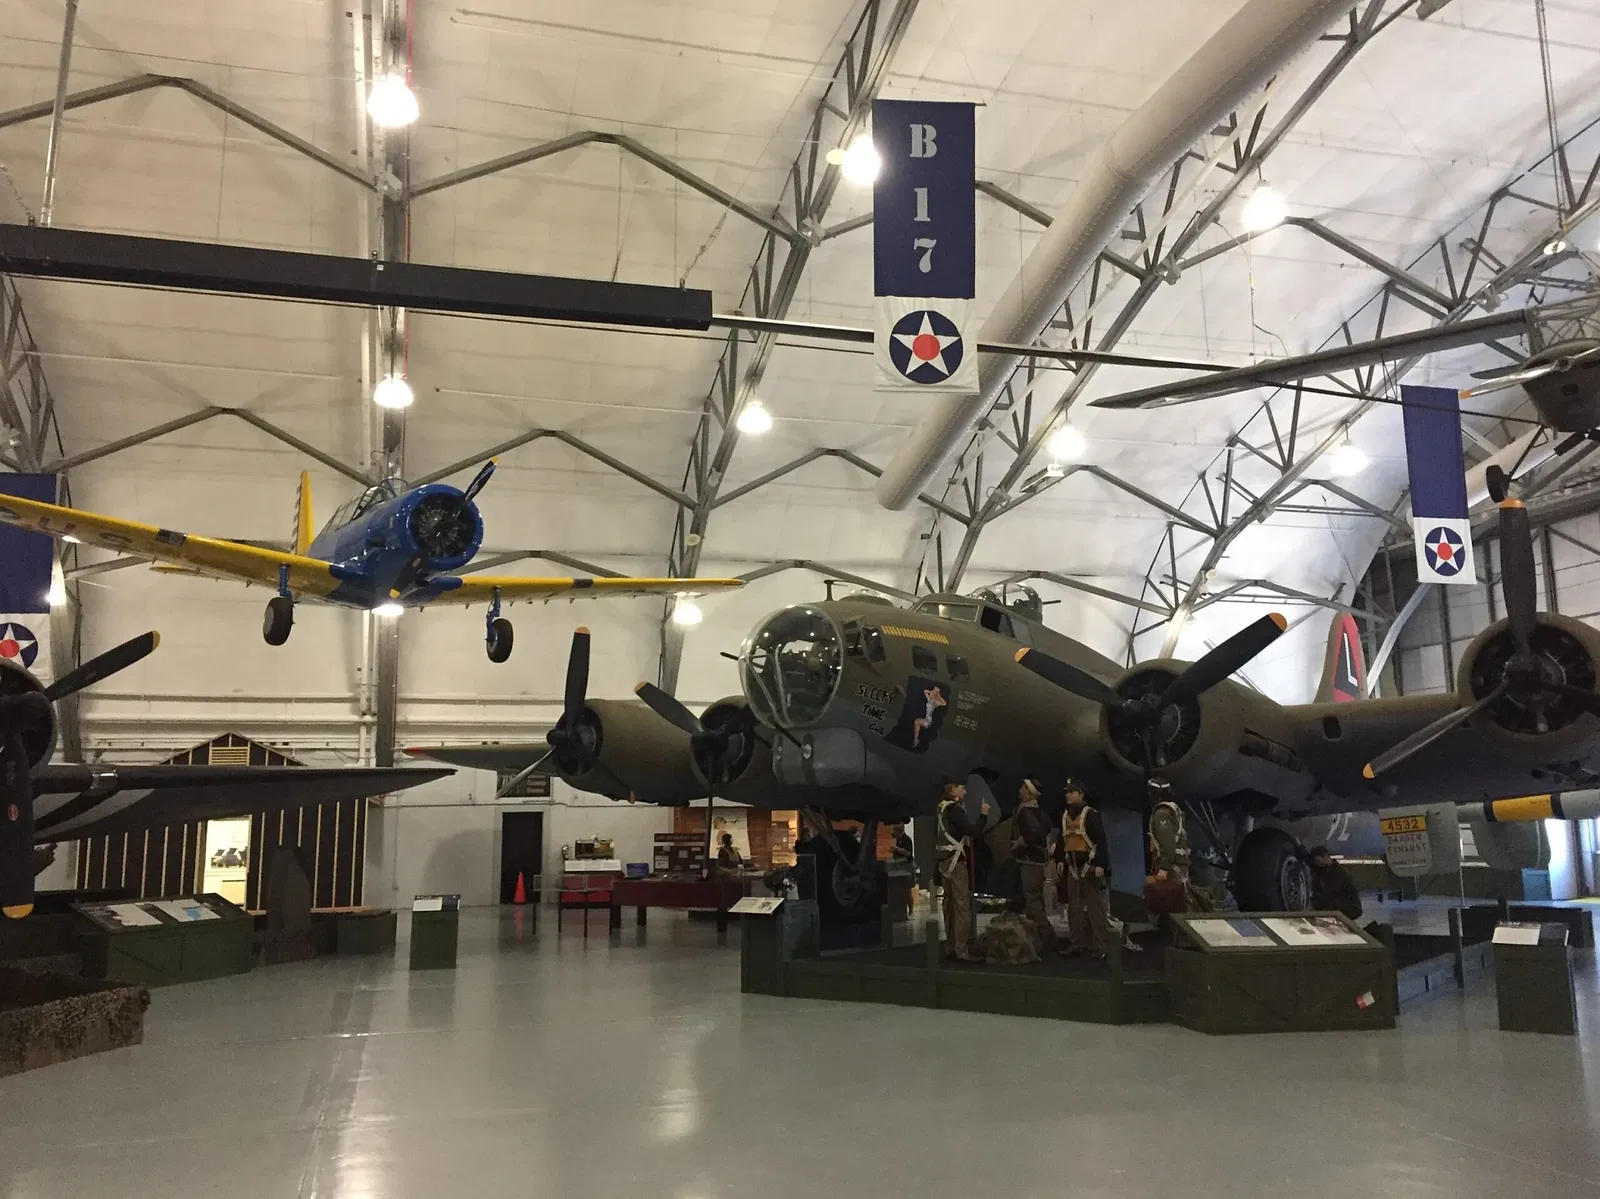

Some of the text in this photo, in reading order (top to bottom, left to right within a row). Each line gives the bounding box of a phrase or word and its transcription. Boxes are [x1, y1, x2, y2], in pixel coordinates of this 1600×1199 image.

[857, 684, 895, 704] SLEEPY
[862, 704, 886, 720] TIME
[1387, 819, 1418, 831] 4532
